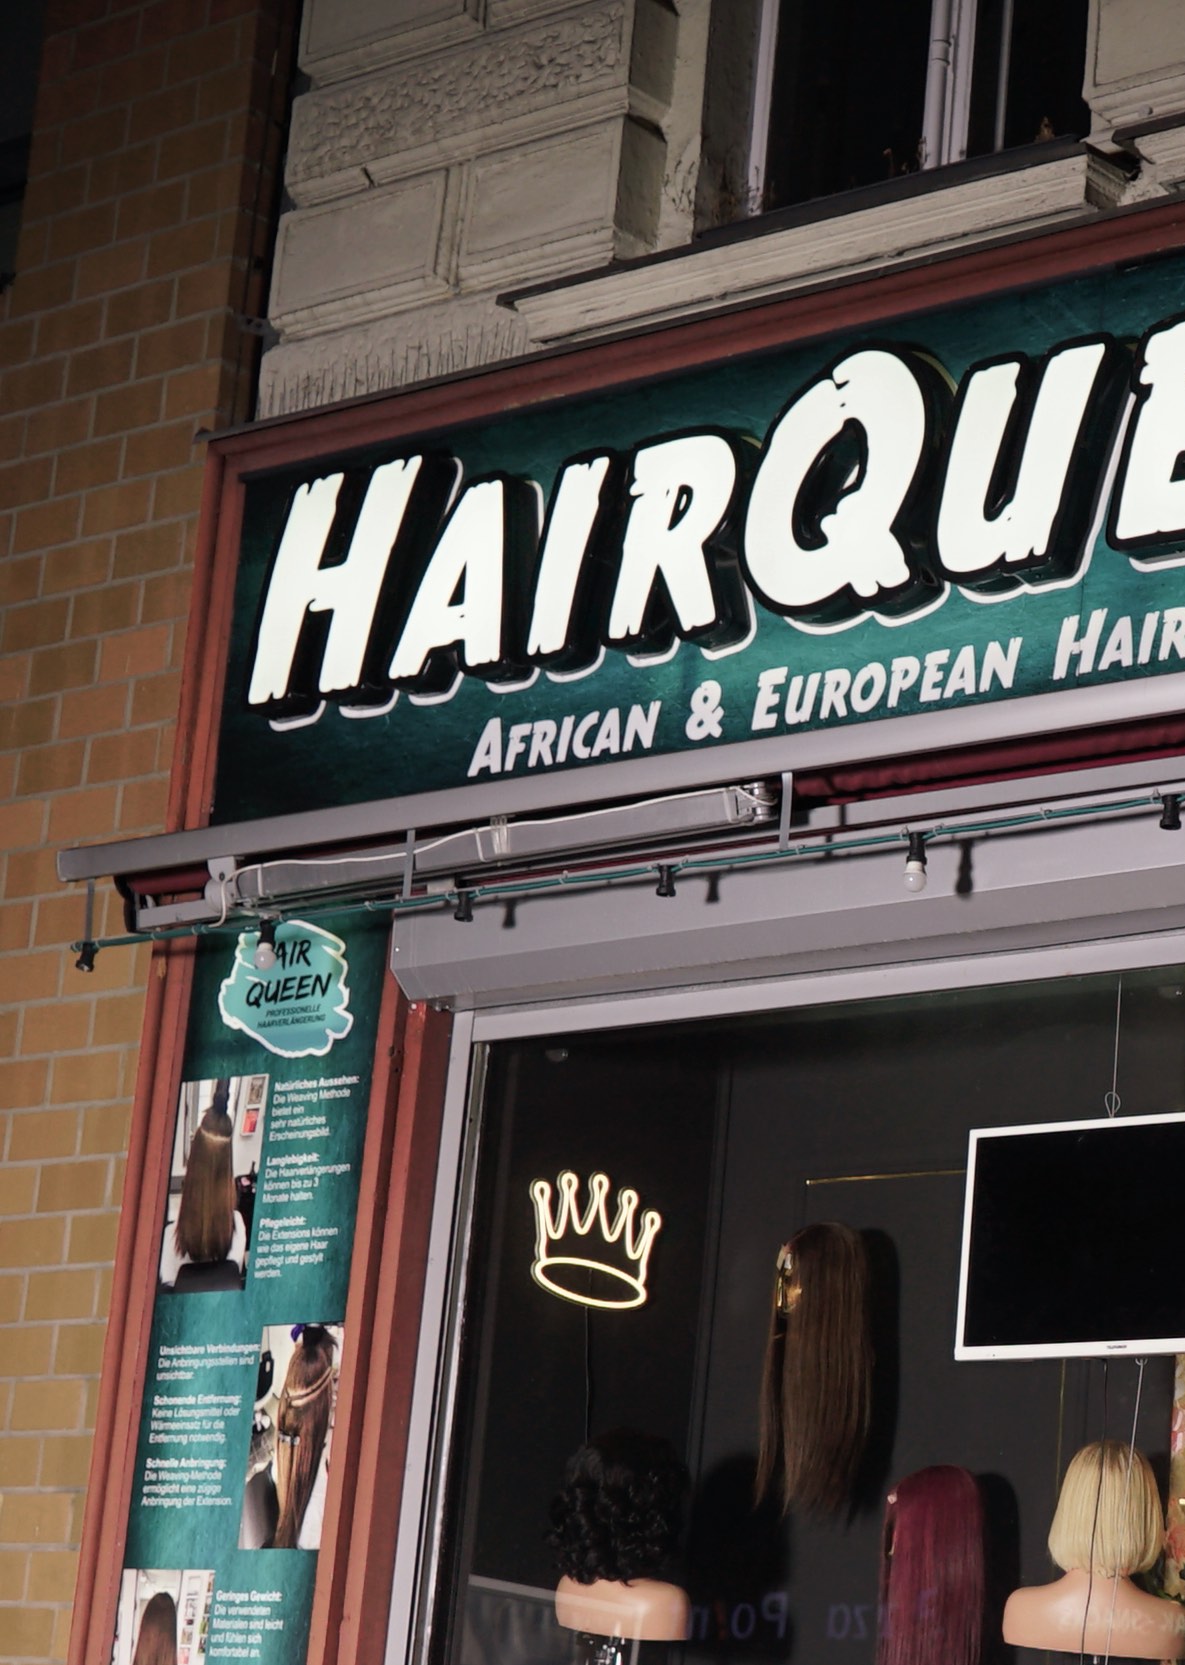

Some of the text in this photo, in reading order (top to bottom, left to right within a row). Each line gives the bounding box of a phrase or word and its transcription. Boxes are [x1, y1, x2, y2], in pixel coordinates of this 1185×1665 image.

[468, 701, 662, 778] AFRICAN
[686, 679, 723, 742] &
[751, 637, 1022, 730] EUROPEAN
[272, 939, 311, 970] AIR
[246, 973, 332, 1009] QUEEN
[257, 1014, 325, 1029] HAARVERLÄNGERUNG
[266, 1004, 321, 1017] PROFESSIONELLE
